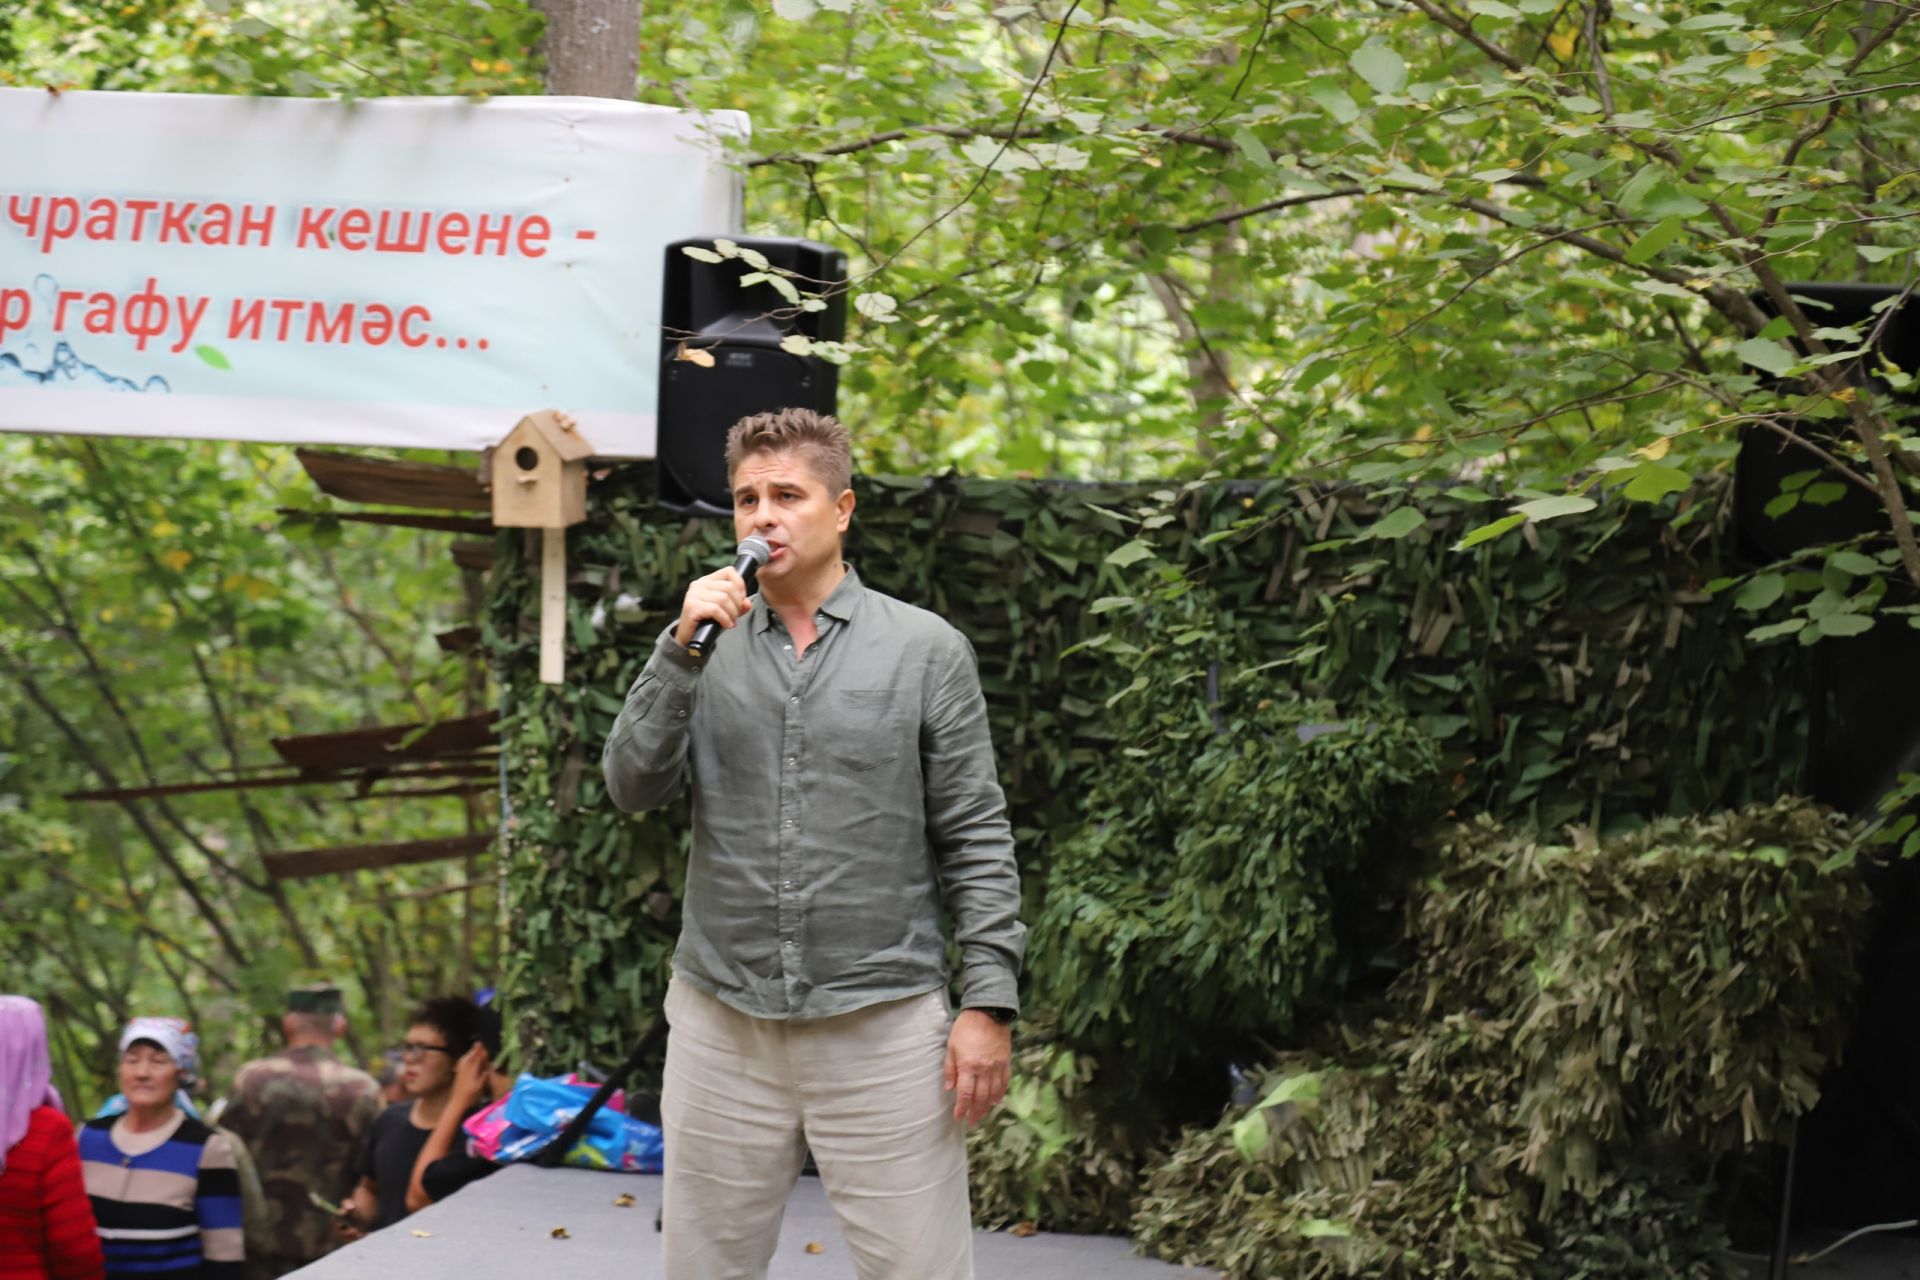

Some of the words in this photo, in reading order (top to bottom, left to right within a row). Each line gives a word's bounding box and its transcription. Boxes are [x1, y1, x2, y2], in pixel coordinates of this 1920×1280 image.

[0, 194, 277, 254] чраткан
[296, 206, 553, 259] кешене
[53, 276, 211, 354] гафу
[226, 297, 490, 351] итмәс...
